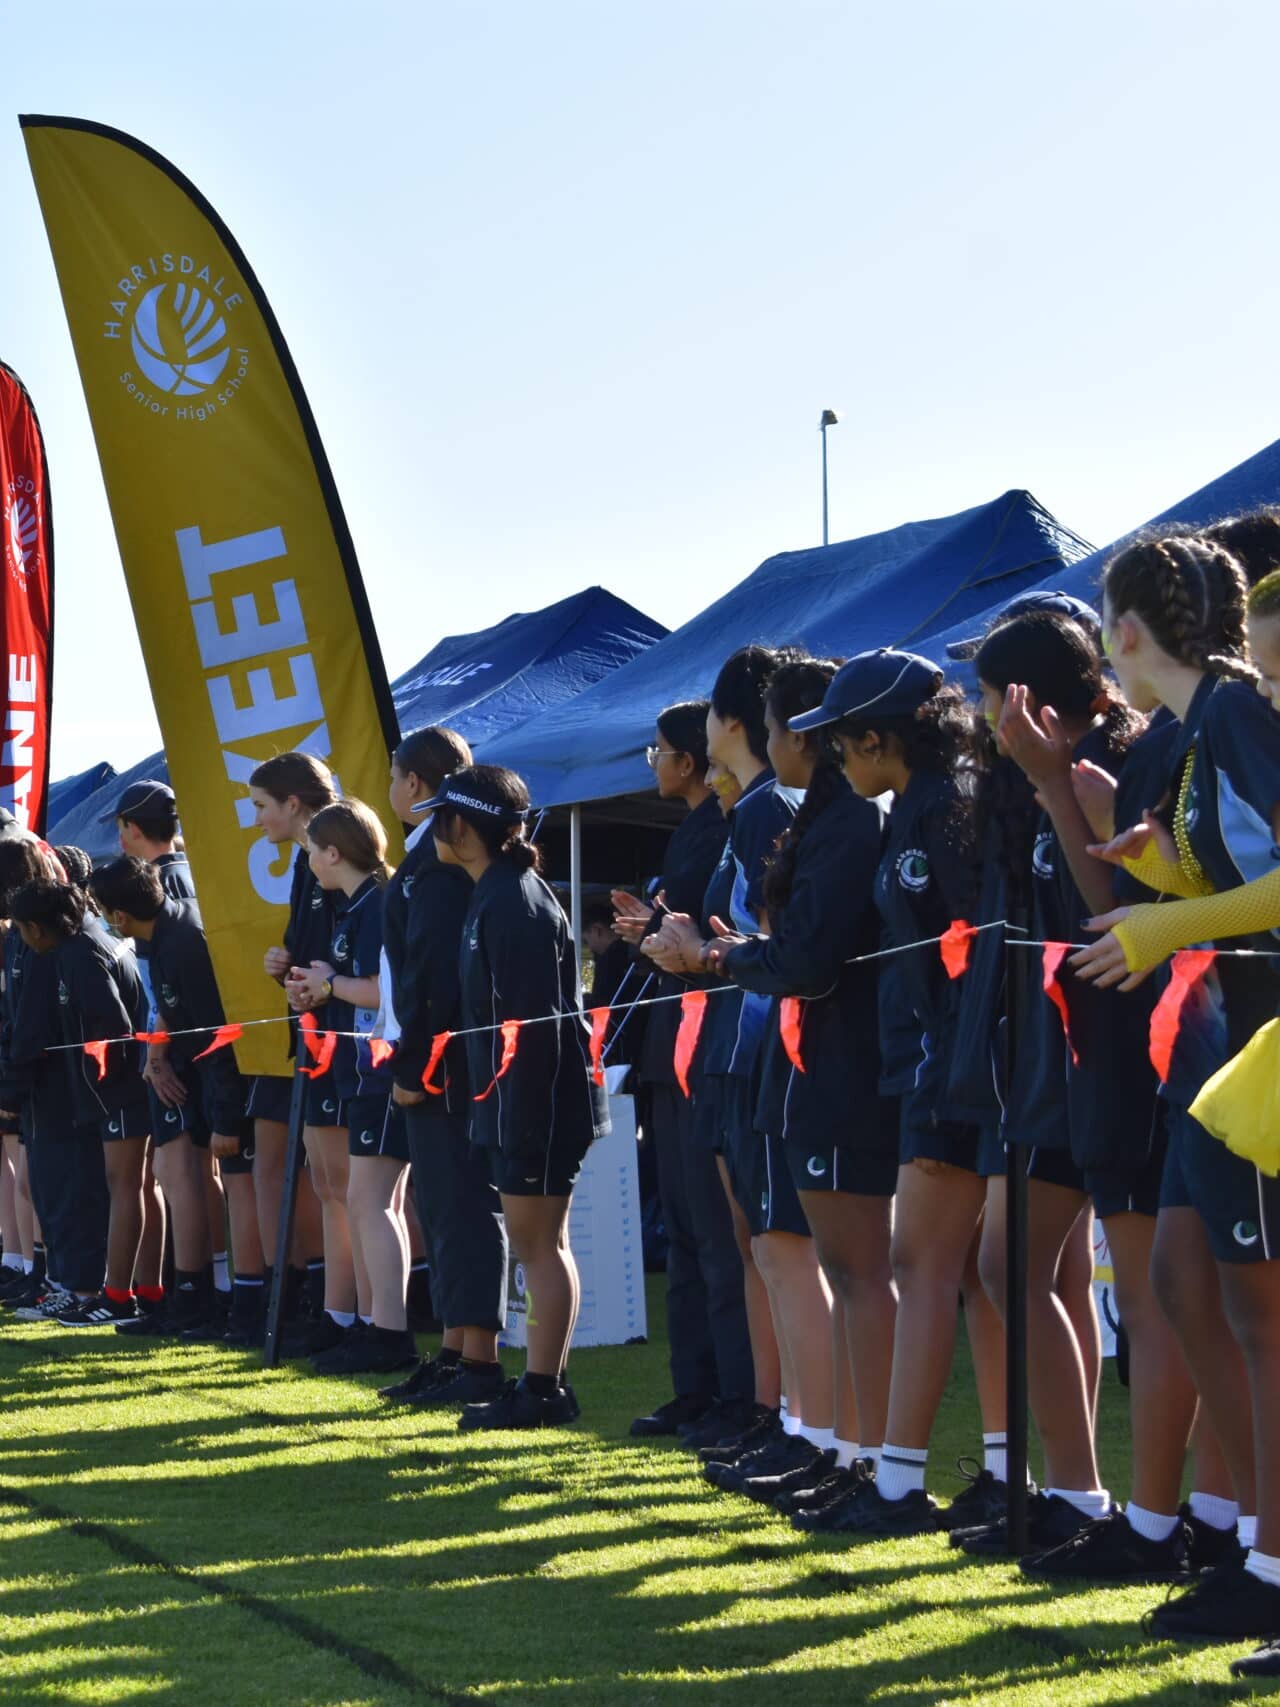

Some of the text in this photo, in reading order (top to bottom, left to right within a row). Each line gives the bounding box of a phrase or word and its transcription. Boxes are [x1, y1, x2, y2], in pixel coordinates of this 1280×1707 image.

[104, 254, 243, 339] HARRISDALE
[120, 347, 249, 421] Senior High School
[446, 790, 502, 815] HARRISDALE
